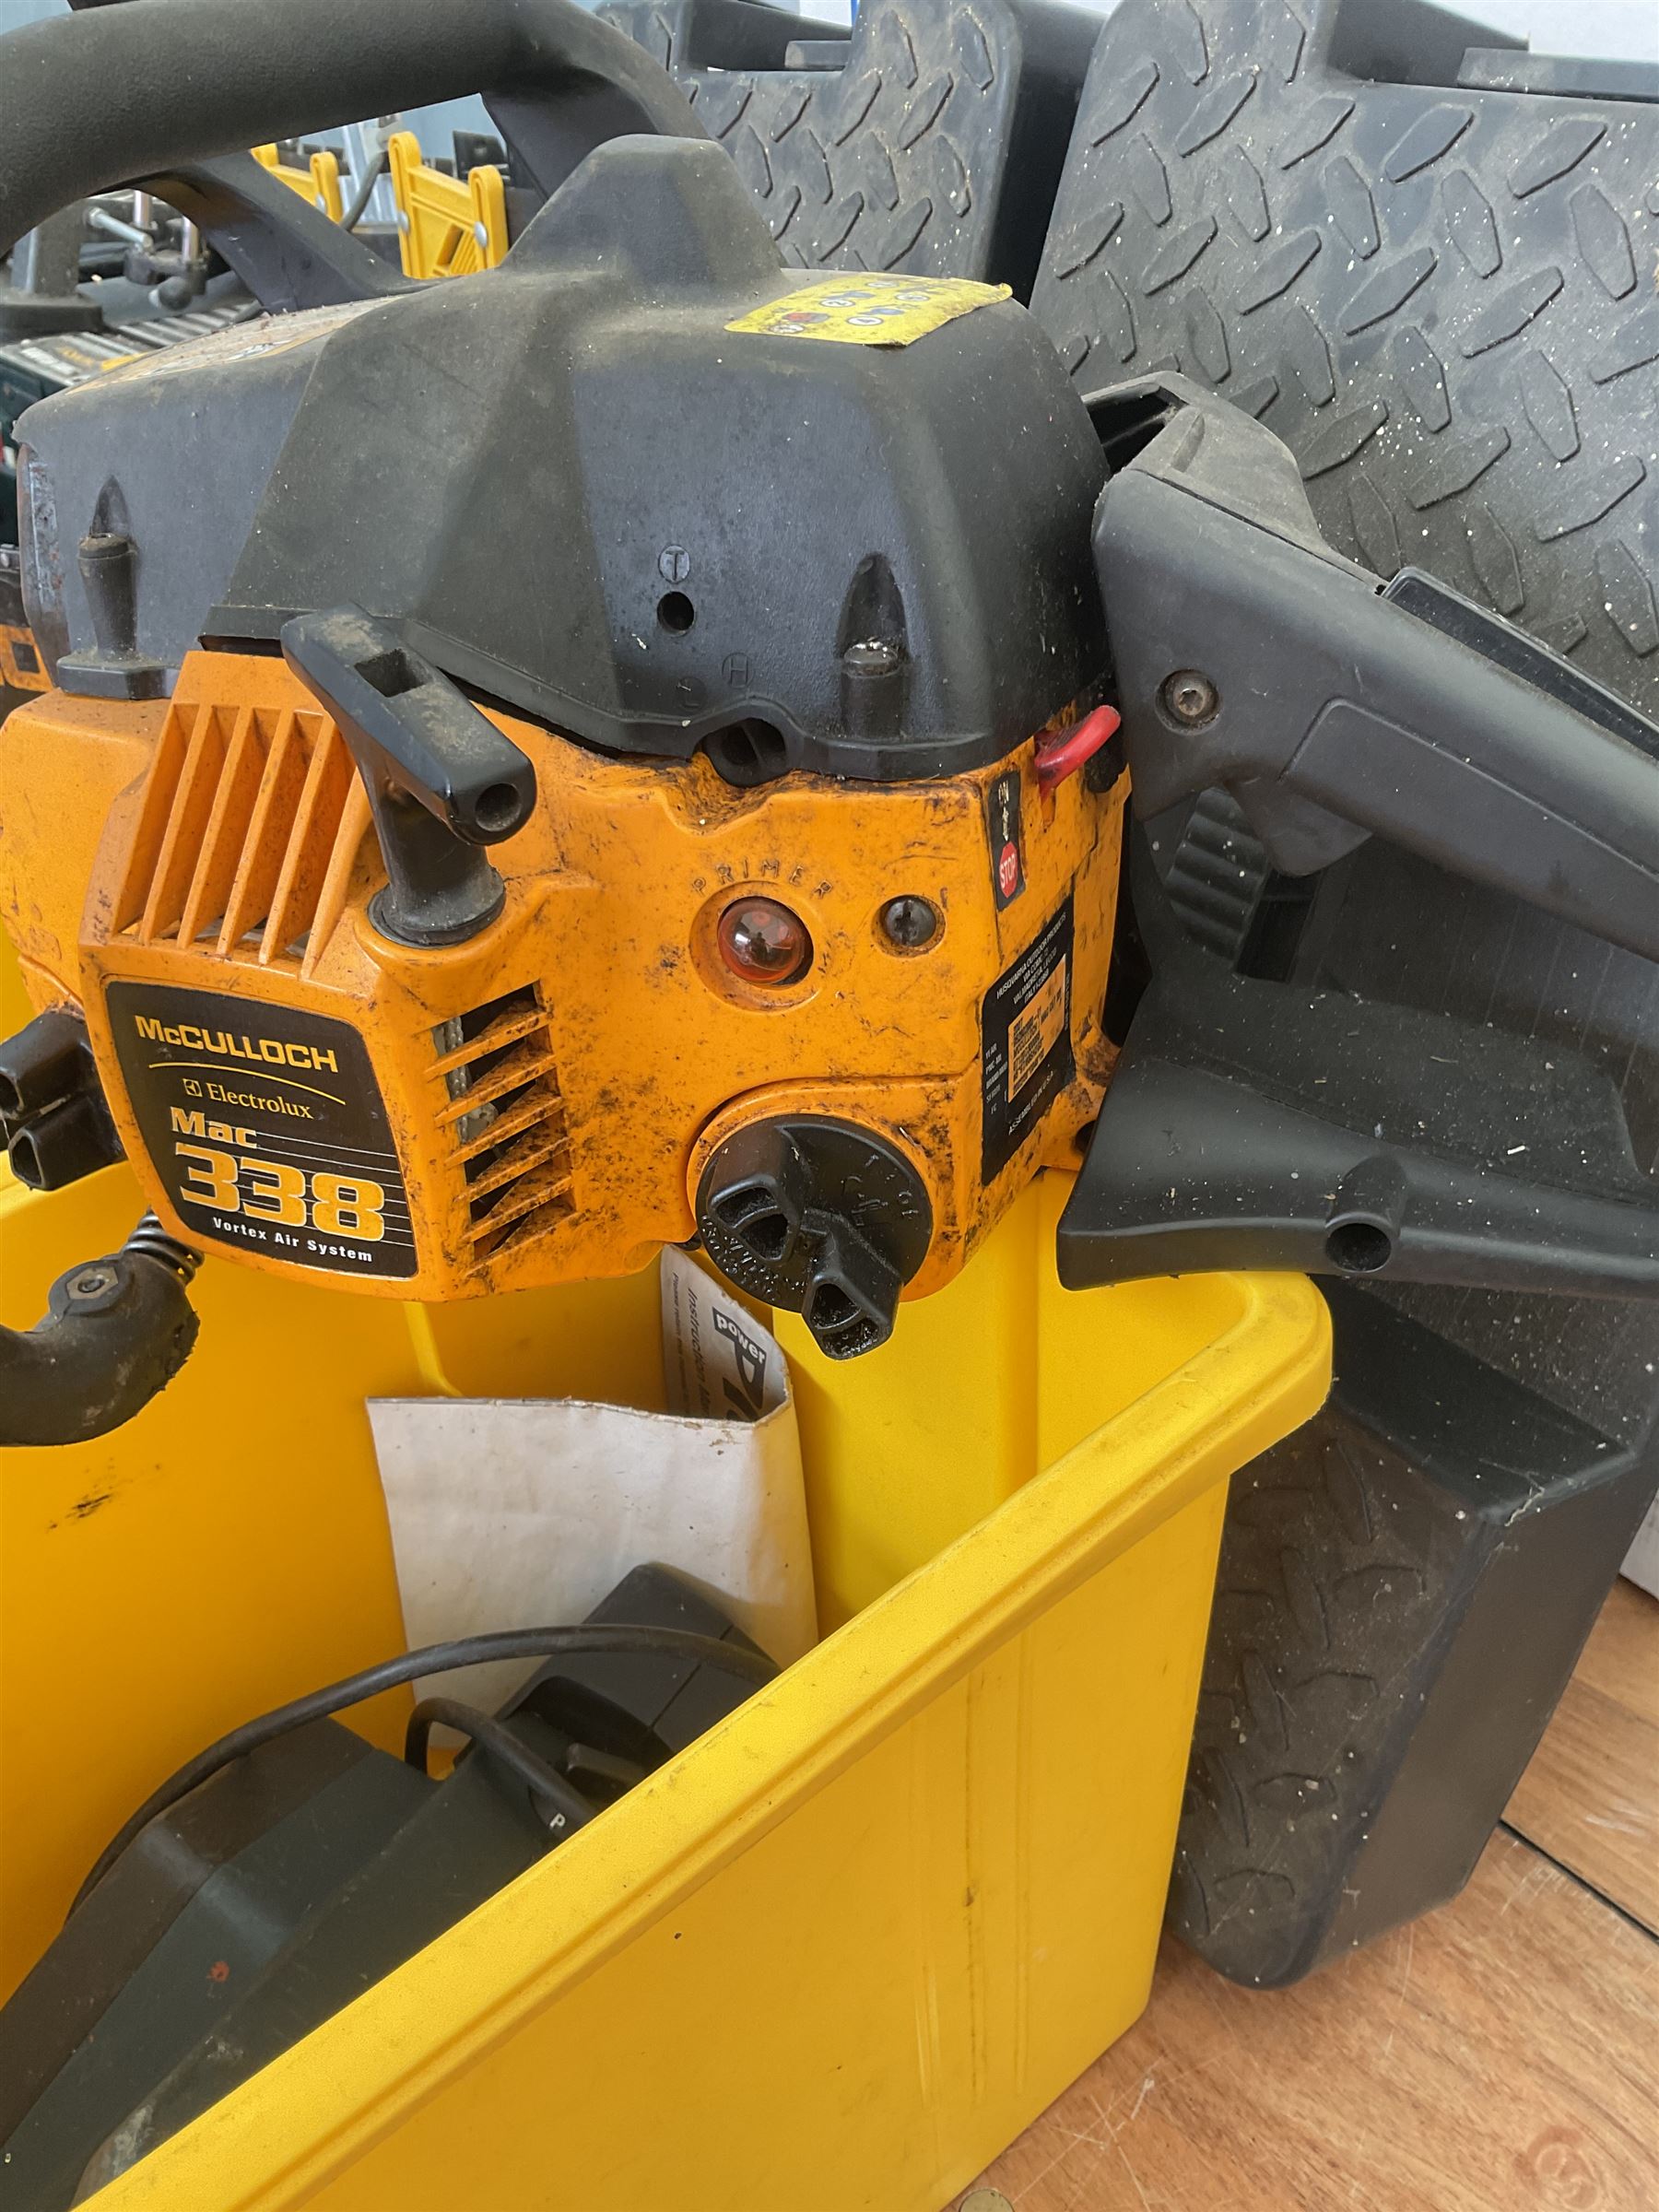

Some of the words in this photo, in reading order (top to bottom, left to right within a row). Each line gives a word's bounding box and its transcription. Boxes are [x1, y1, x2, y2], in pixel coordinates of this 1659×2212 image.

[664, 551, 686, 582] T
[729, 657, 749, 686] H
[691, 859, 834, 899] PRIMER
[999, 853, 1016, 889] STOP
[134, 1015, 339, 1074] McCULLOCH
[206, 1082, 315, 1120] Electrolux
[170, 1106, 258, 1149] Mac
[174, 1142, 385, 1242] 338
[212, 1217, 267, 1241] Vortex
[274, 1230, 300, 1248] Air
[306, 1238, 373, 1263] System
[688, 1288, 707, 1382] Instruction
[716, 1315, 766, 1364] power
